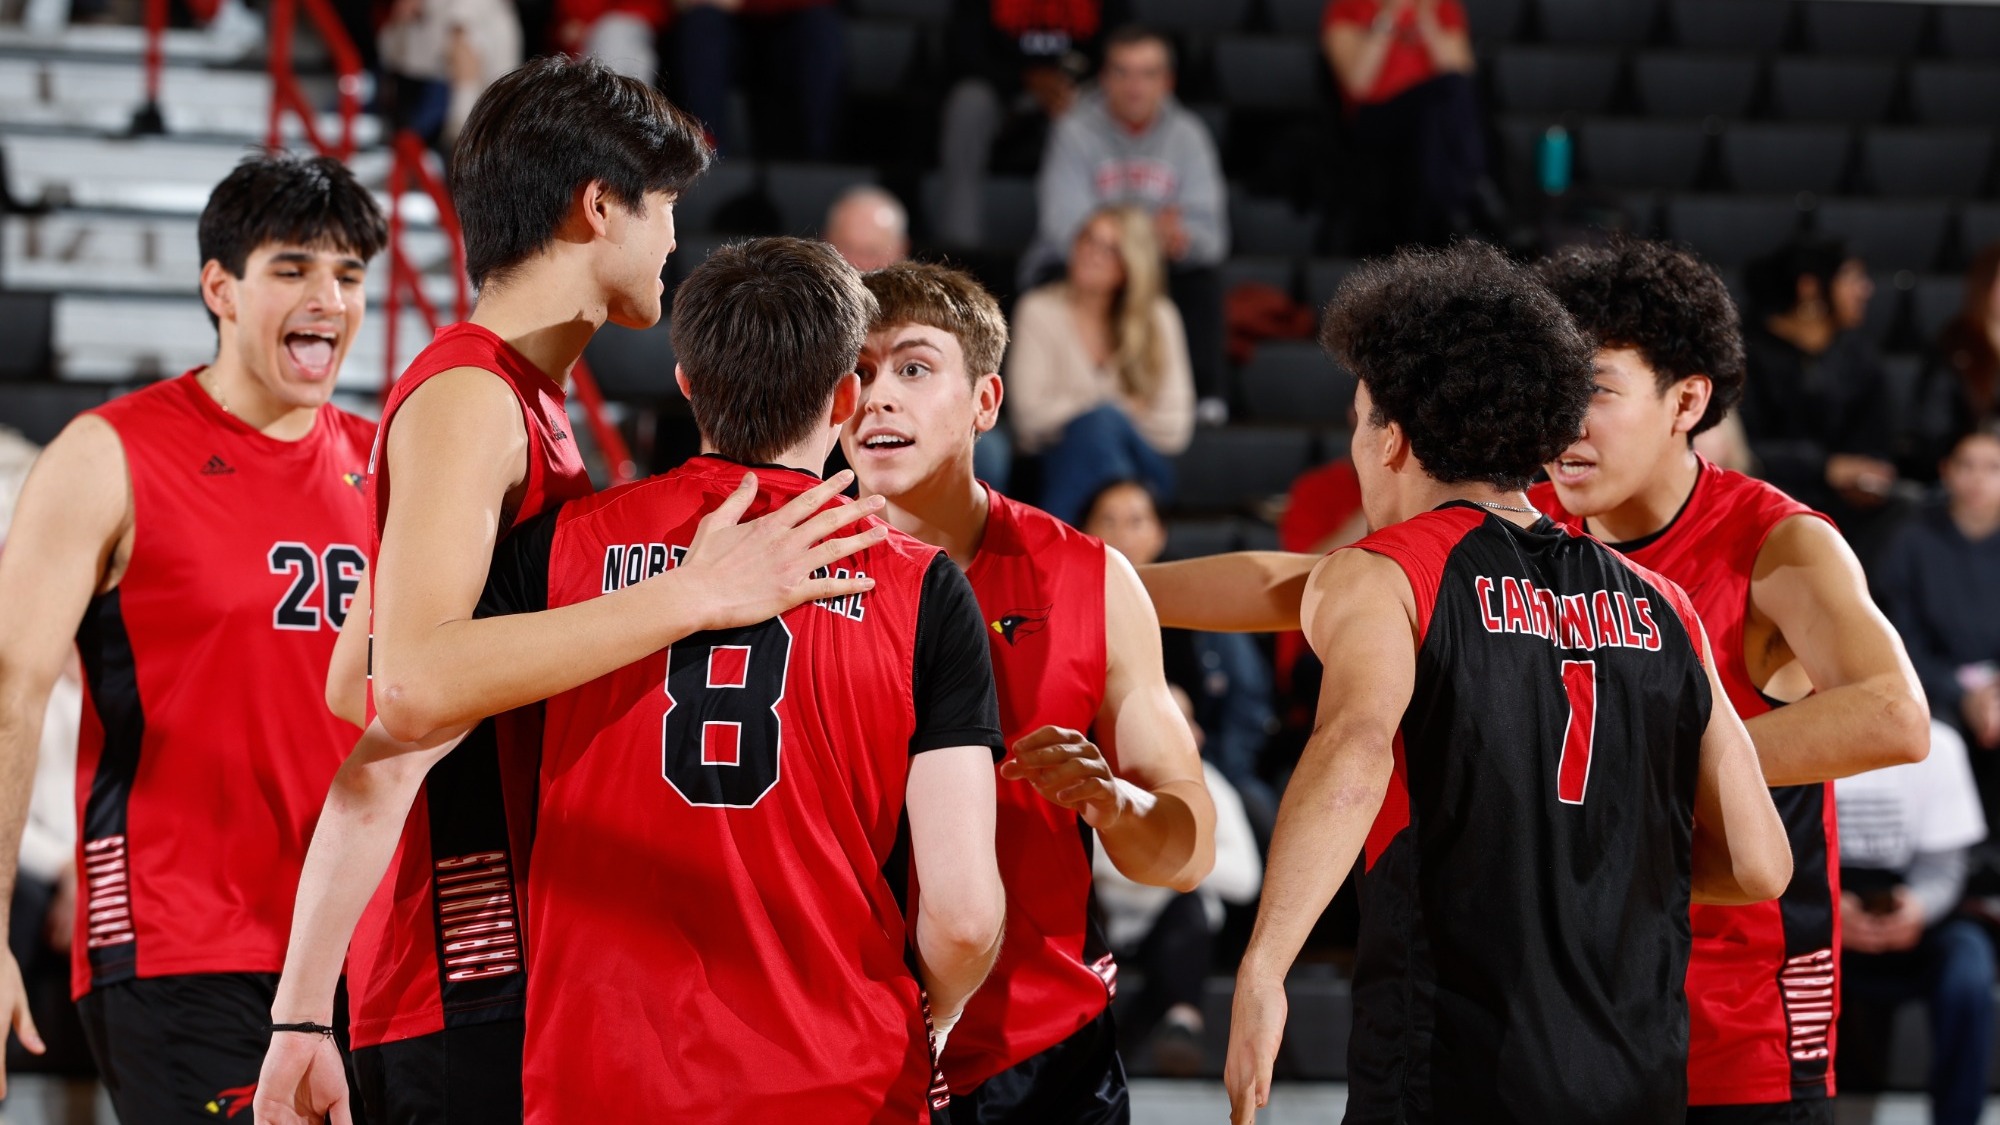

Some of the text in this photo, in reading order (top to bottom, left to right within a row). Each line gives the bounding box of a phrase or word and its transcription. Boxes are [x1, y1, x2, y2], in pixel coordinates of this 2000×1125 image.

[267, 541, 369, 631] 26
[662, 614, 793, 809] 8
[436, 850, 520, 982] CARDINALS
